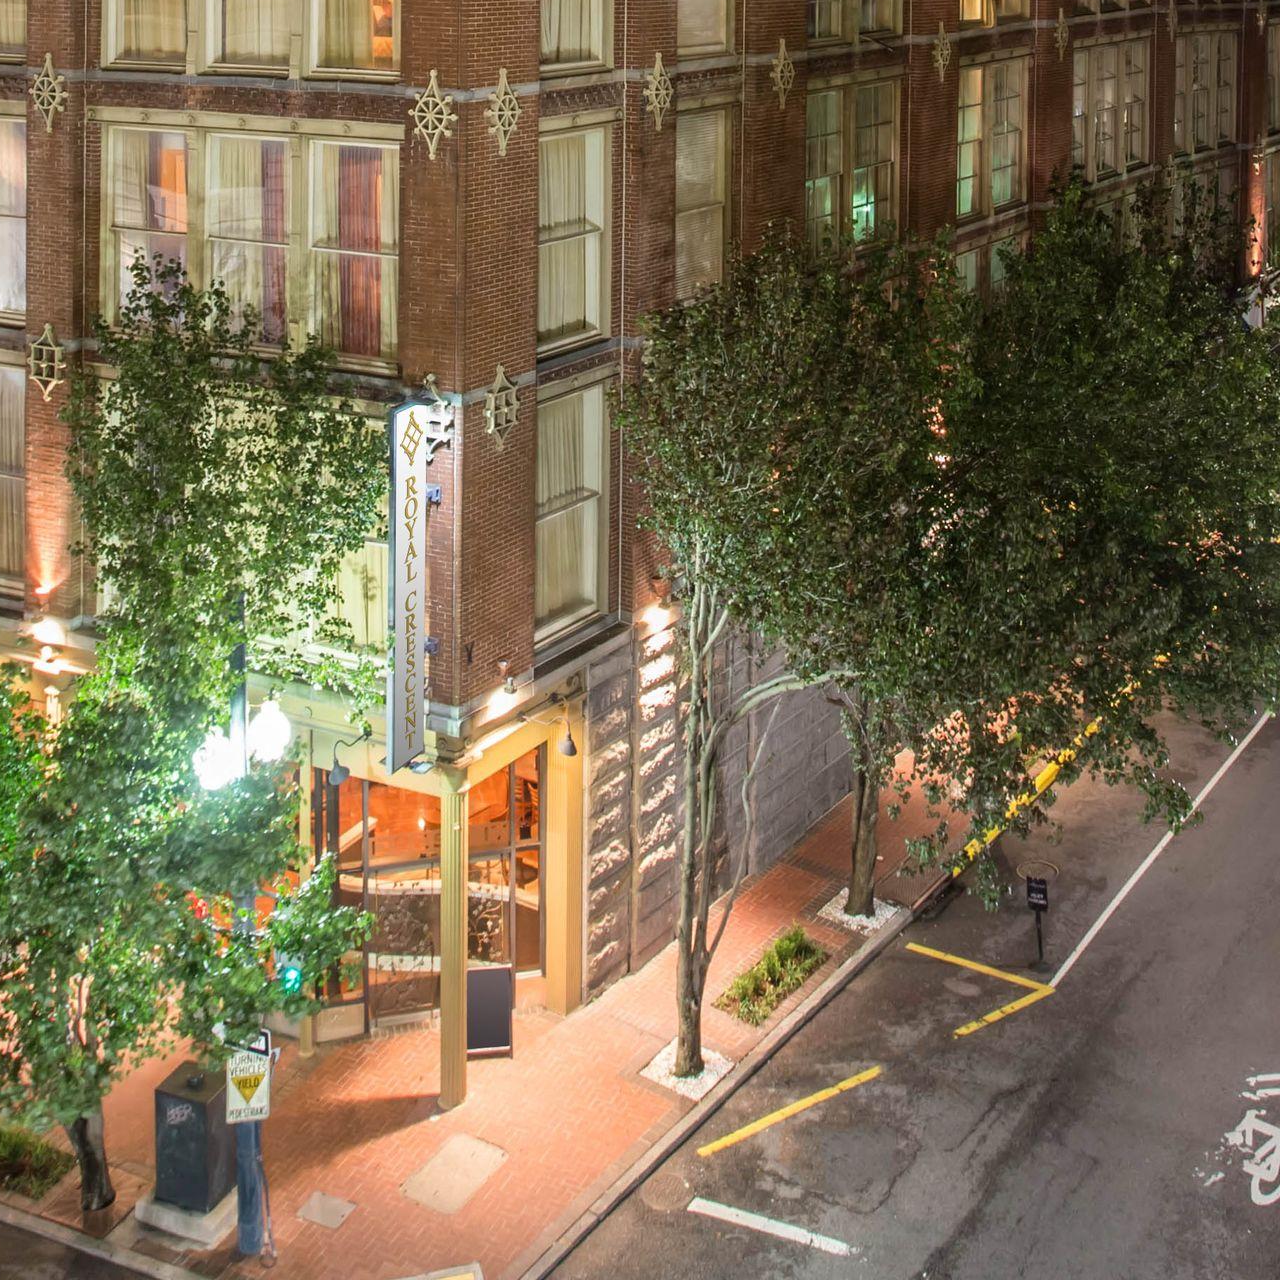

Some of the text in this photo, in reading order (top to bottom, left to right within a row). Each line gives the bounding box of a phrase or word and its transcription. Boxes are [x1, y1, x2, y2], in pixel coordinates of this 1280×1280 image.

[404, 475, 419, 749] ROYAL CRESCENT
[230, 1063, 268, 1076] VEHICLES
[236, 1077, 260, 1090] YIELD
